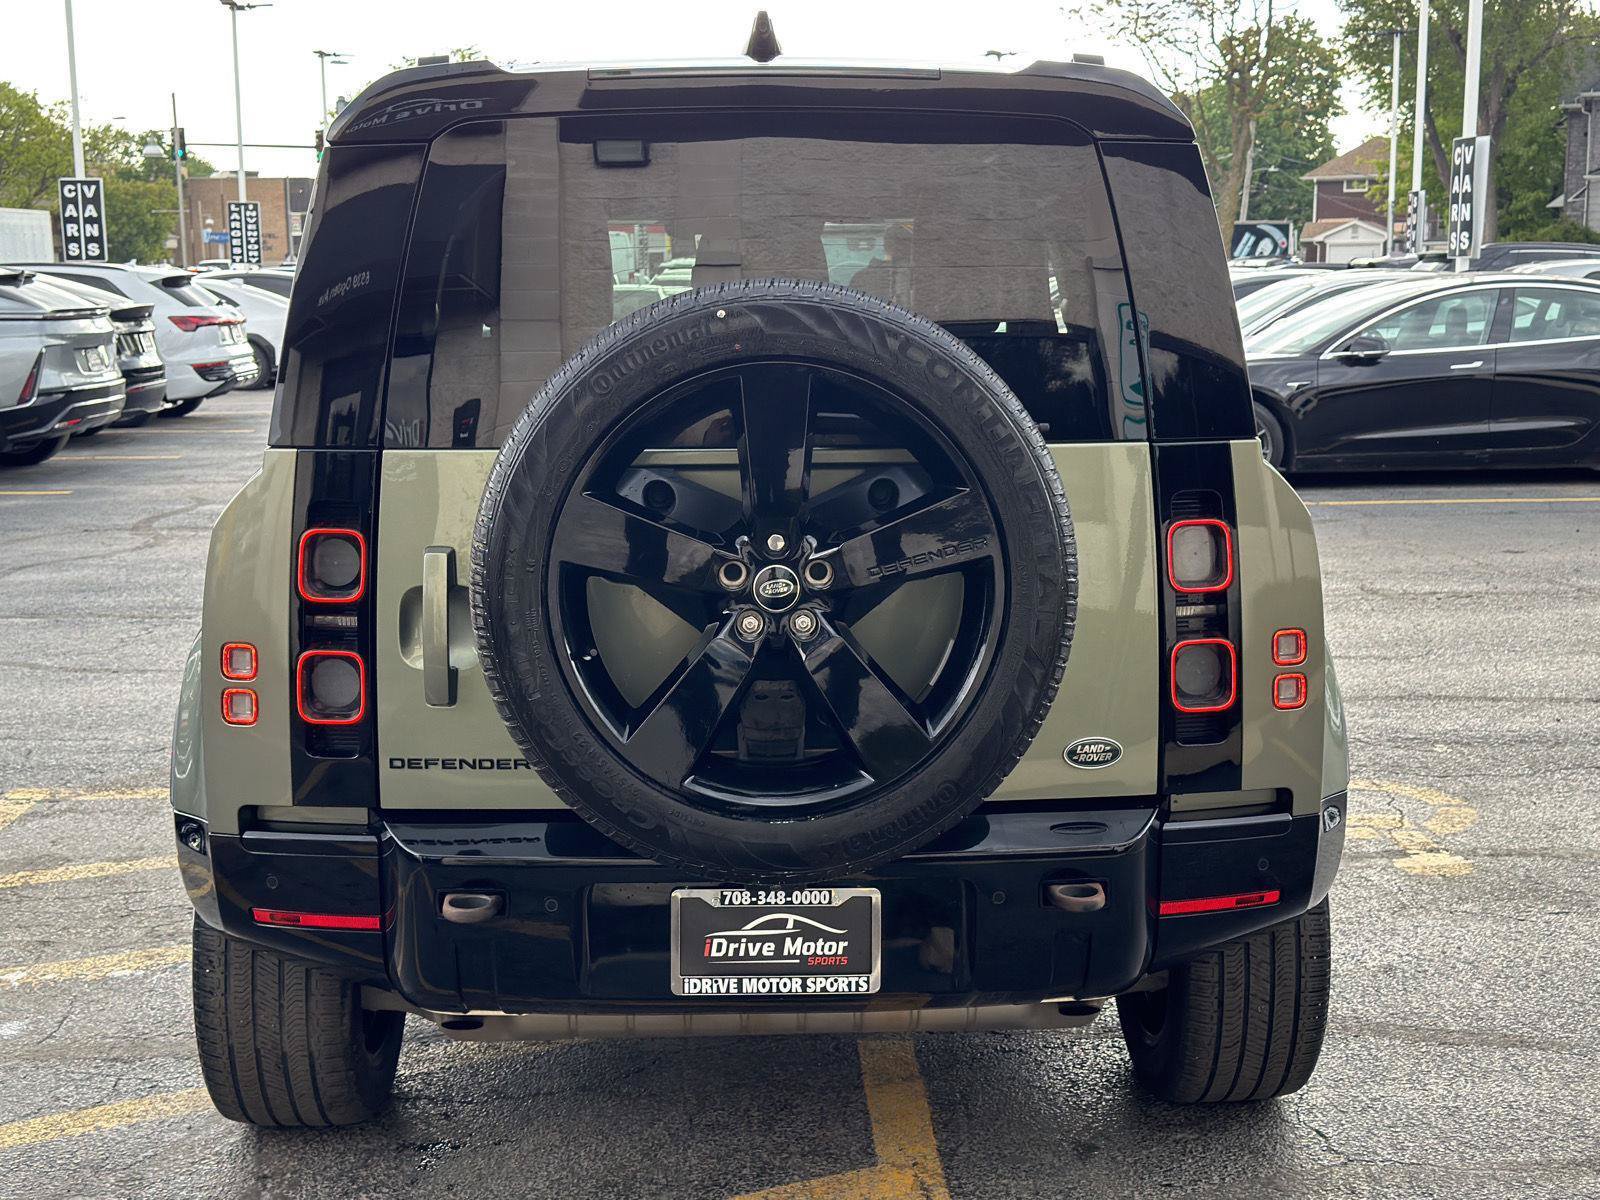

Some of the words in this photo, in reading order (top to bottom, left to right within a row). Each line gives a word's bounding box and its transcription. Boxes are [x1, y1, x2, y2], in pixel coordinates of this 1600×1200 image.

[1450, 147, 1461, 250] CARS
[1460, 145, 1474, 249] VANS
[63, 184, 80, 256] CARS
[82, 184, 100, 256] VANS
[230, 204, 242, 262] LARGEST
[246, 204, 259, 263] INVENTORY
[867, 538, 990, 578] DEFENDER
[389, 758, 531, 769] DEFENDER
[1077, 745, 1104, 753] LAND
[1079, 753, 1112, 761] ROVER
[722, 891, 830, 904] 708-348-0000
[704, 938, 775, 957] iDrive
[783, 937, 848, 956] Motor
[808, 957, 848, 965] SPORTS
[742, 978, 802, 993] MOTOR
[806, 977, 868, 992] SPORTS
